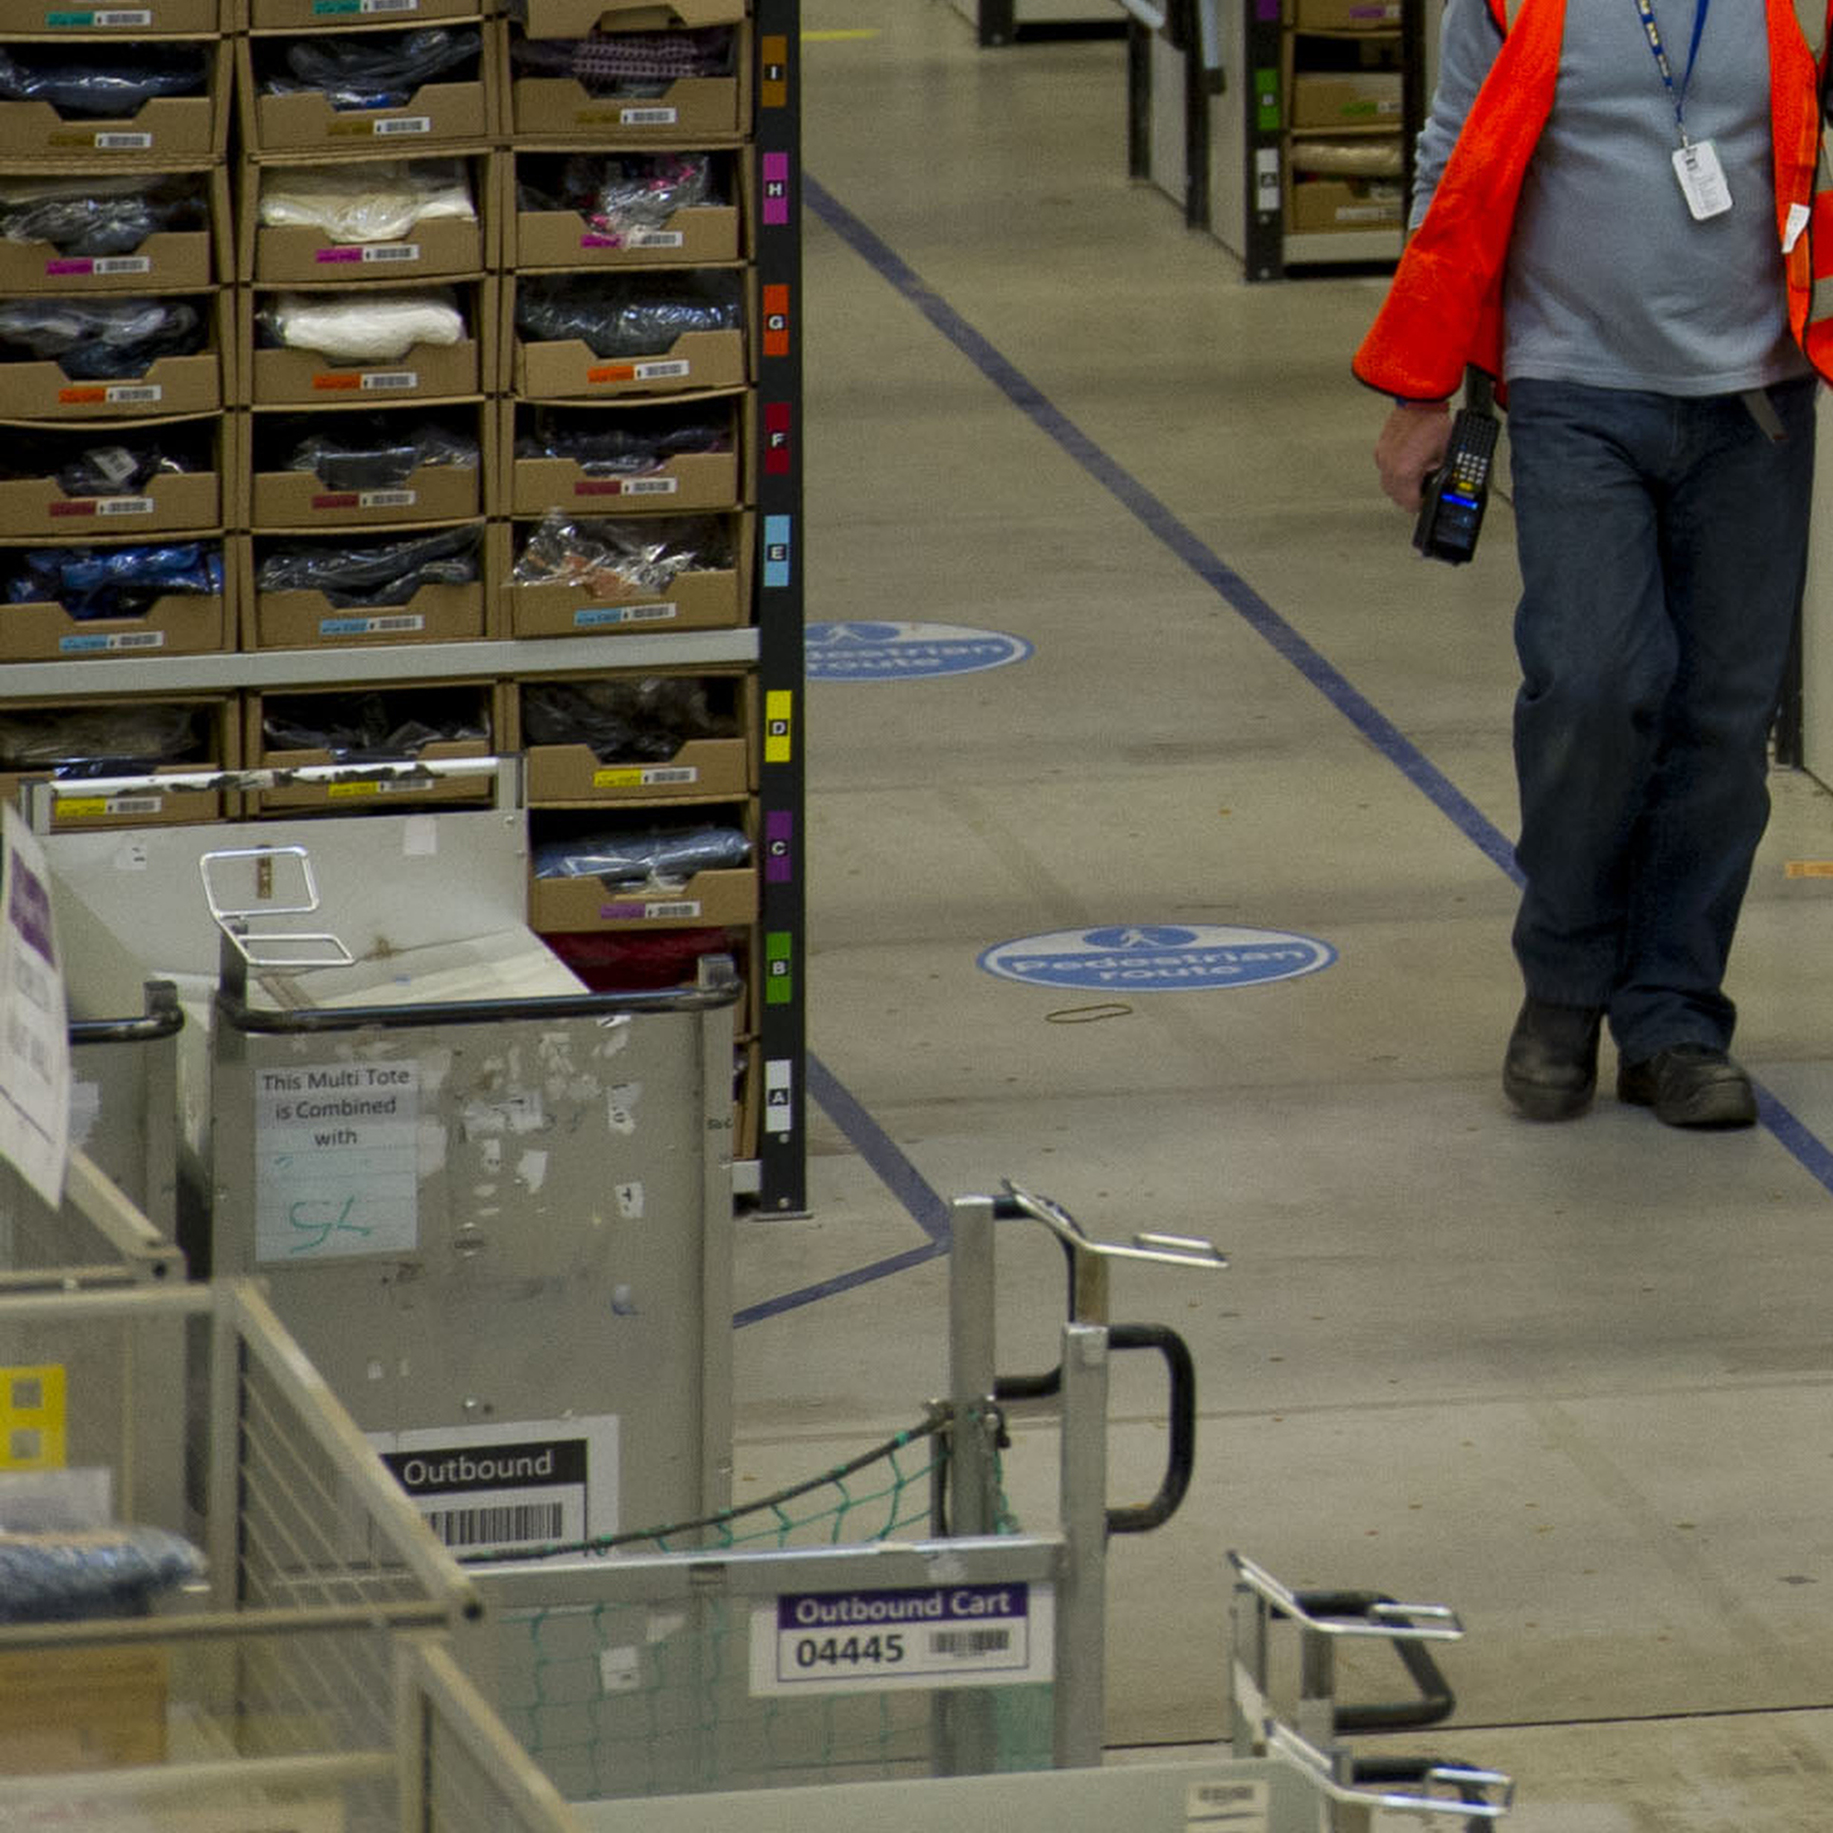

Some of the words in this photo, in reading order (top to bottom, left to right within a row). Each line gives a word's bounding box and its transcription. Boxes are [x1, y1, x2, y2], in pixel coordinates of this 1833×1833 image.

[771, 66, 777, 79] I
[769, 183, 782, 196] H
[769, 316, 783, 329] G
[772, 433, 783, 447] F
[771, 546, 783, 560] E
[773, 722, 786, 734] D
[772, 841, 785, 855] C
[1011, 949, 1305, 972] Pedestrian
[773, 961, 786, 975] B
[1101, 964, 1240, 980] route
[263, 1074, 304, 1092] This
[307, 1070, 359, 1090] Multi
[366, 1068, 410, 1086] Tote
[772, 1091, 785, 1103] A
[276, 1103, 292, 1121] is
[296, 1096, 397, 1119] Combined
[314, 1128, 358, 1148] with
[403, 1449, 554, 1485] Outbound
[796, 1593, 942, 1623] Outbound
[951, 1590, 1011, 1615] Cart
[796, 1633, 905, 1667] 04445
